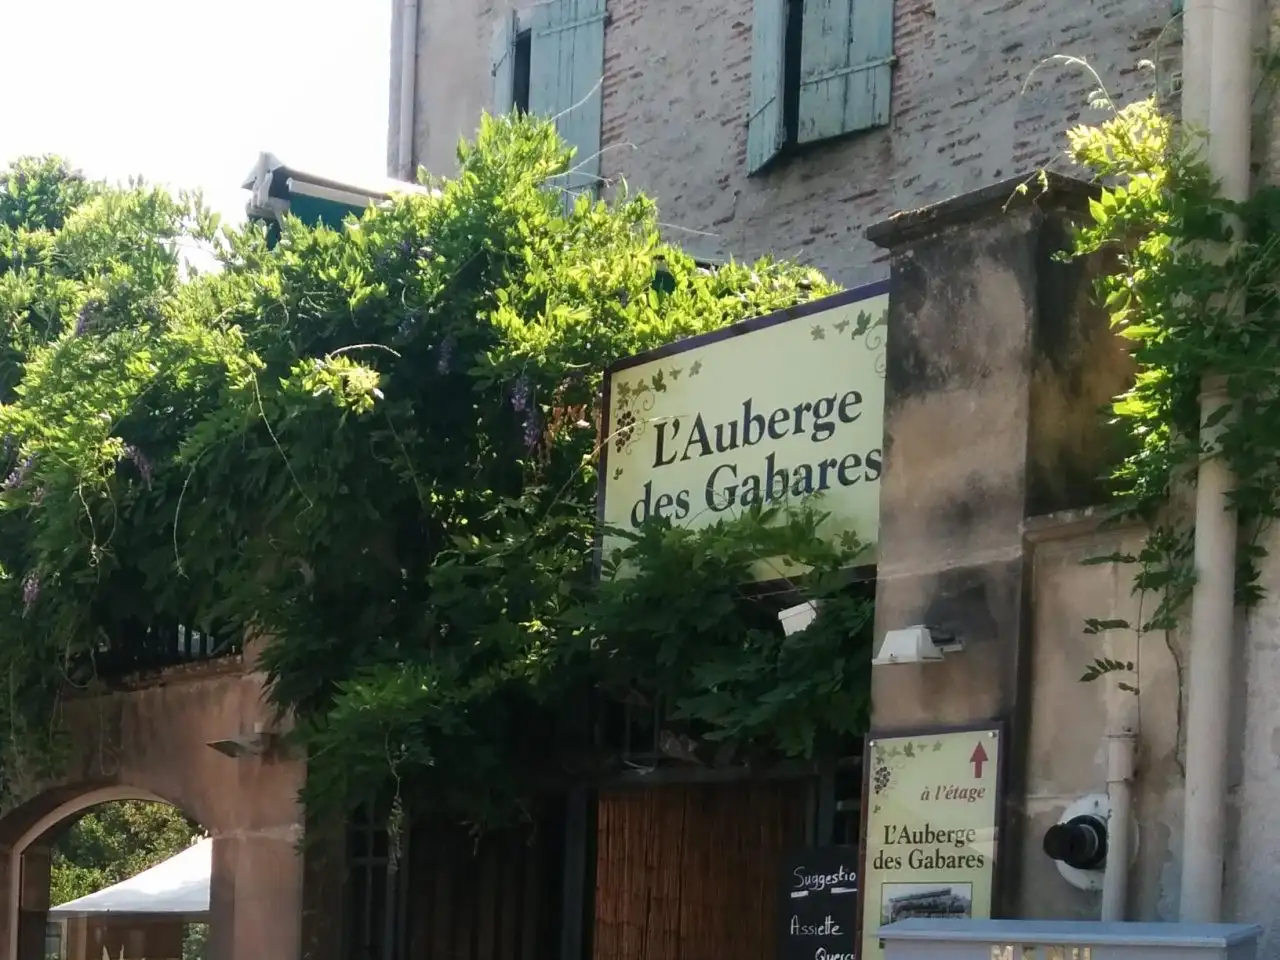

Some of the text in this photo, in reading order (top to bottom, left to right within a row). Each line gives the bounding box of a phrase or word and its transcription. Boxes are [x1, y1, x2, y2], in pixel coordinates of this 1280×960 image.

[652, 389, 863, 468] L'Auberge
[631, 448, 883, 529] des Gabares
[935, 784, 986, 802] l'étage
[884, 823, 976, 848] L'Auberge
[873, 848, 985, 870] des Gabares
[790, 914, 844, 935] Assiette
